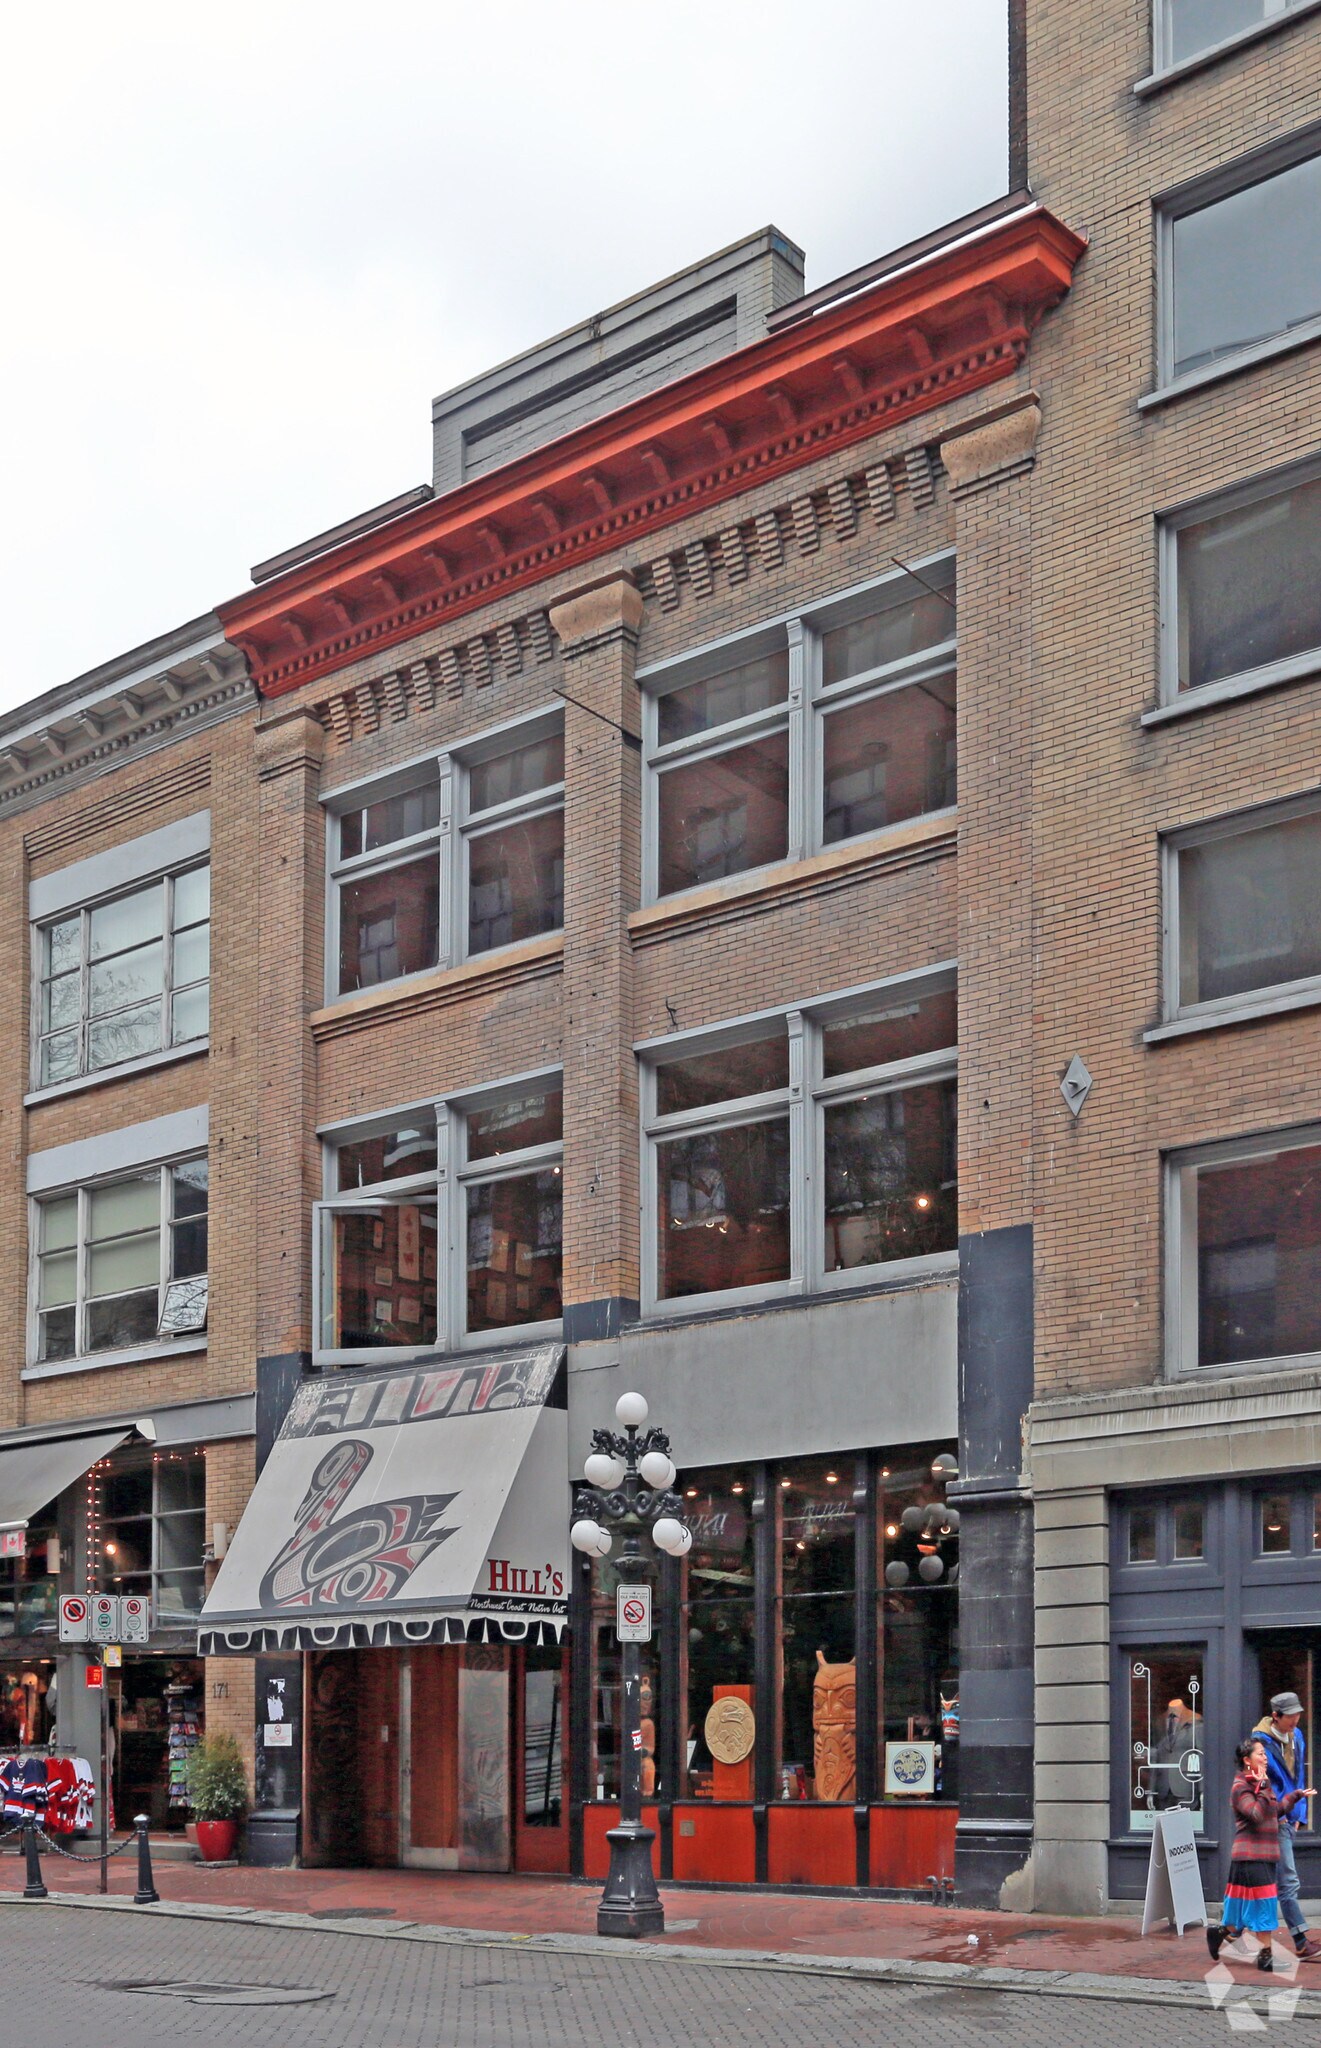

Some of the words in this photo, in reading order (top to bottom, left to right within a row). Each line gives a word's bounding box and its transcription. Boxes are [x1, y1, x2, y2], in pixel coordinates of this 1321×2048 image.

[470, 1598, 507, 1610] Northwest
[506, 1599, 527, 1611] Coast
[528, 1602, 550, 1613] Native
[552, 1601, 567, 1614] Art
[212, 1682, 229, 1698] 171
[1169, 1843, 1194, 1858] INDOCHINO
